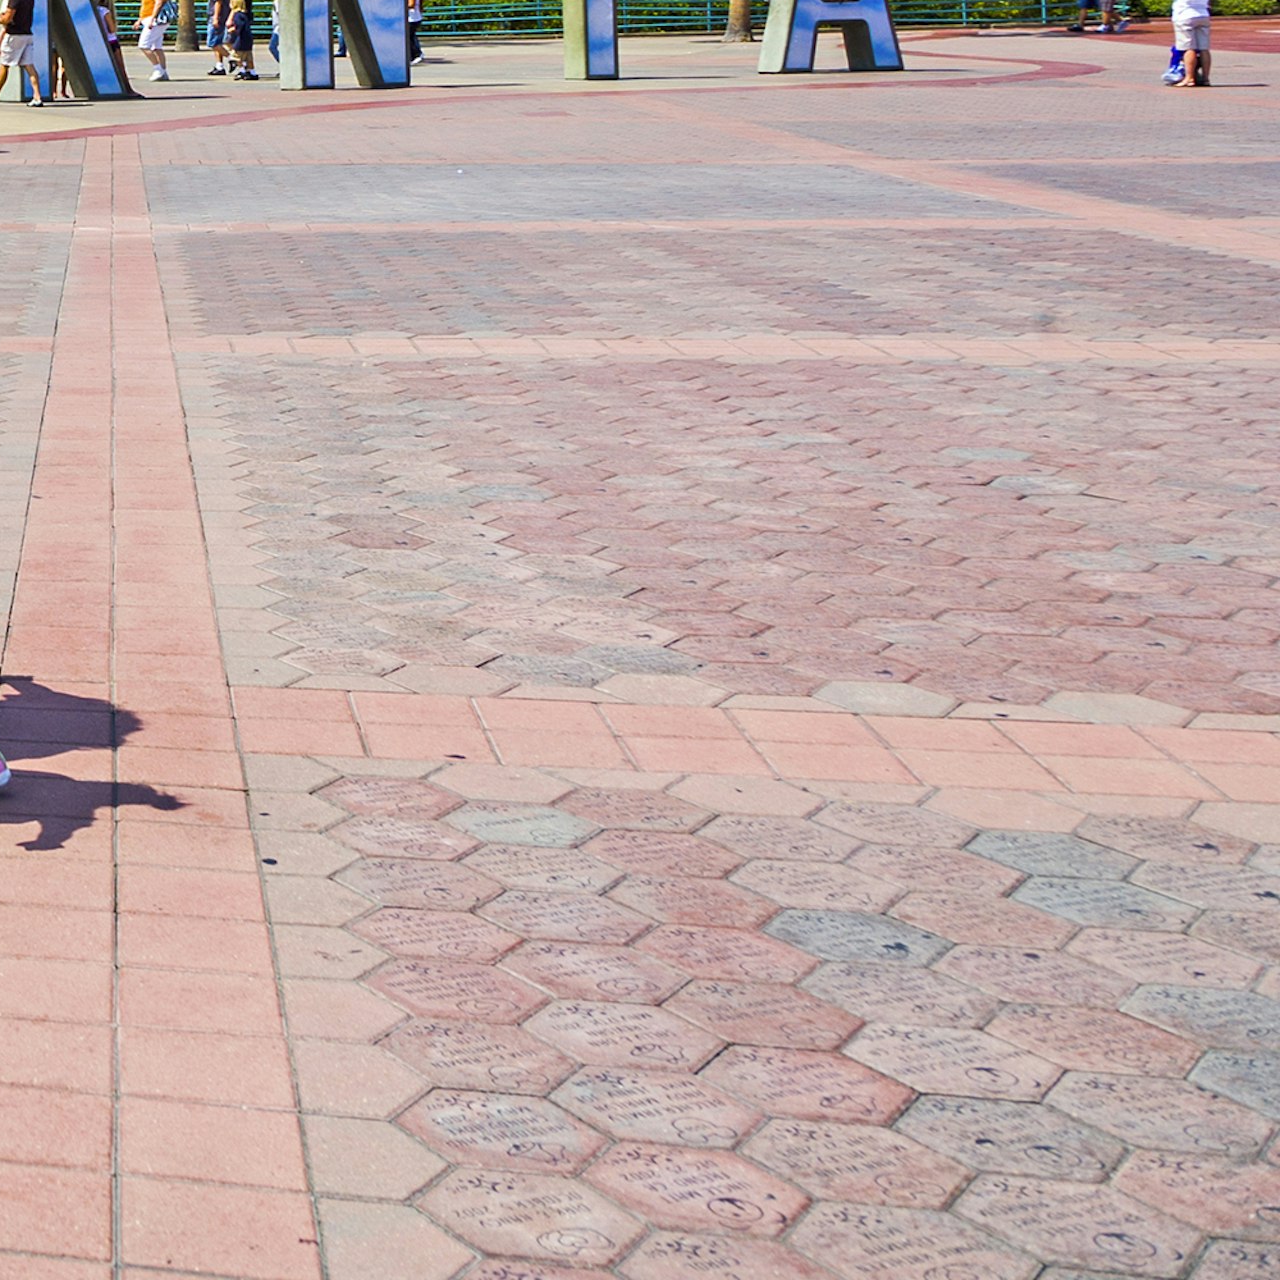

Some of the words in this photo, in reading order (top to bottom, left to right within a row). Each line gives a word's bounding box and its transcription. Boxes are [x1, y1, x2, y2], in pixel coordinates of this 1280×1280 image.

[595, 1096, 658, 1112] MARILYN
[608, 1108, 662, 1123] FAMILY
[482, 1121, 575, 1143] CHRISTOPHER
[620, 1168, 658, 1183] 2002
[707, 1181, 752, 1196] UNCLE
[514, 1190, 580, 1209] OCTOBER
[661, 1190, 702, 1203] MATT
[453, 1205, 490, 1219] 2002
[479, 1212, 532, 1229] NANCY
[690, 1255, 739, 1272] CAROL
